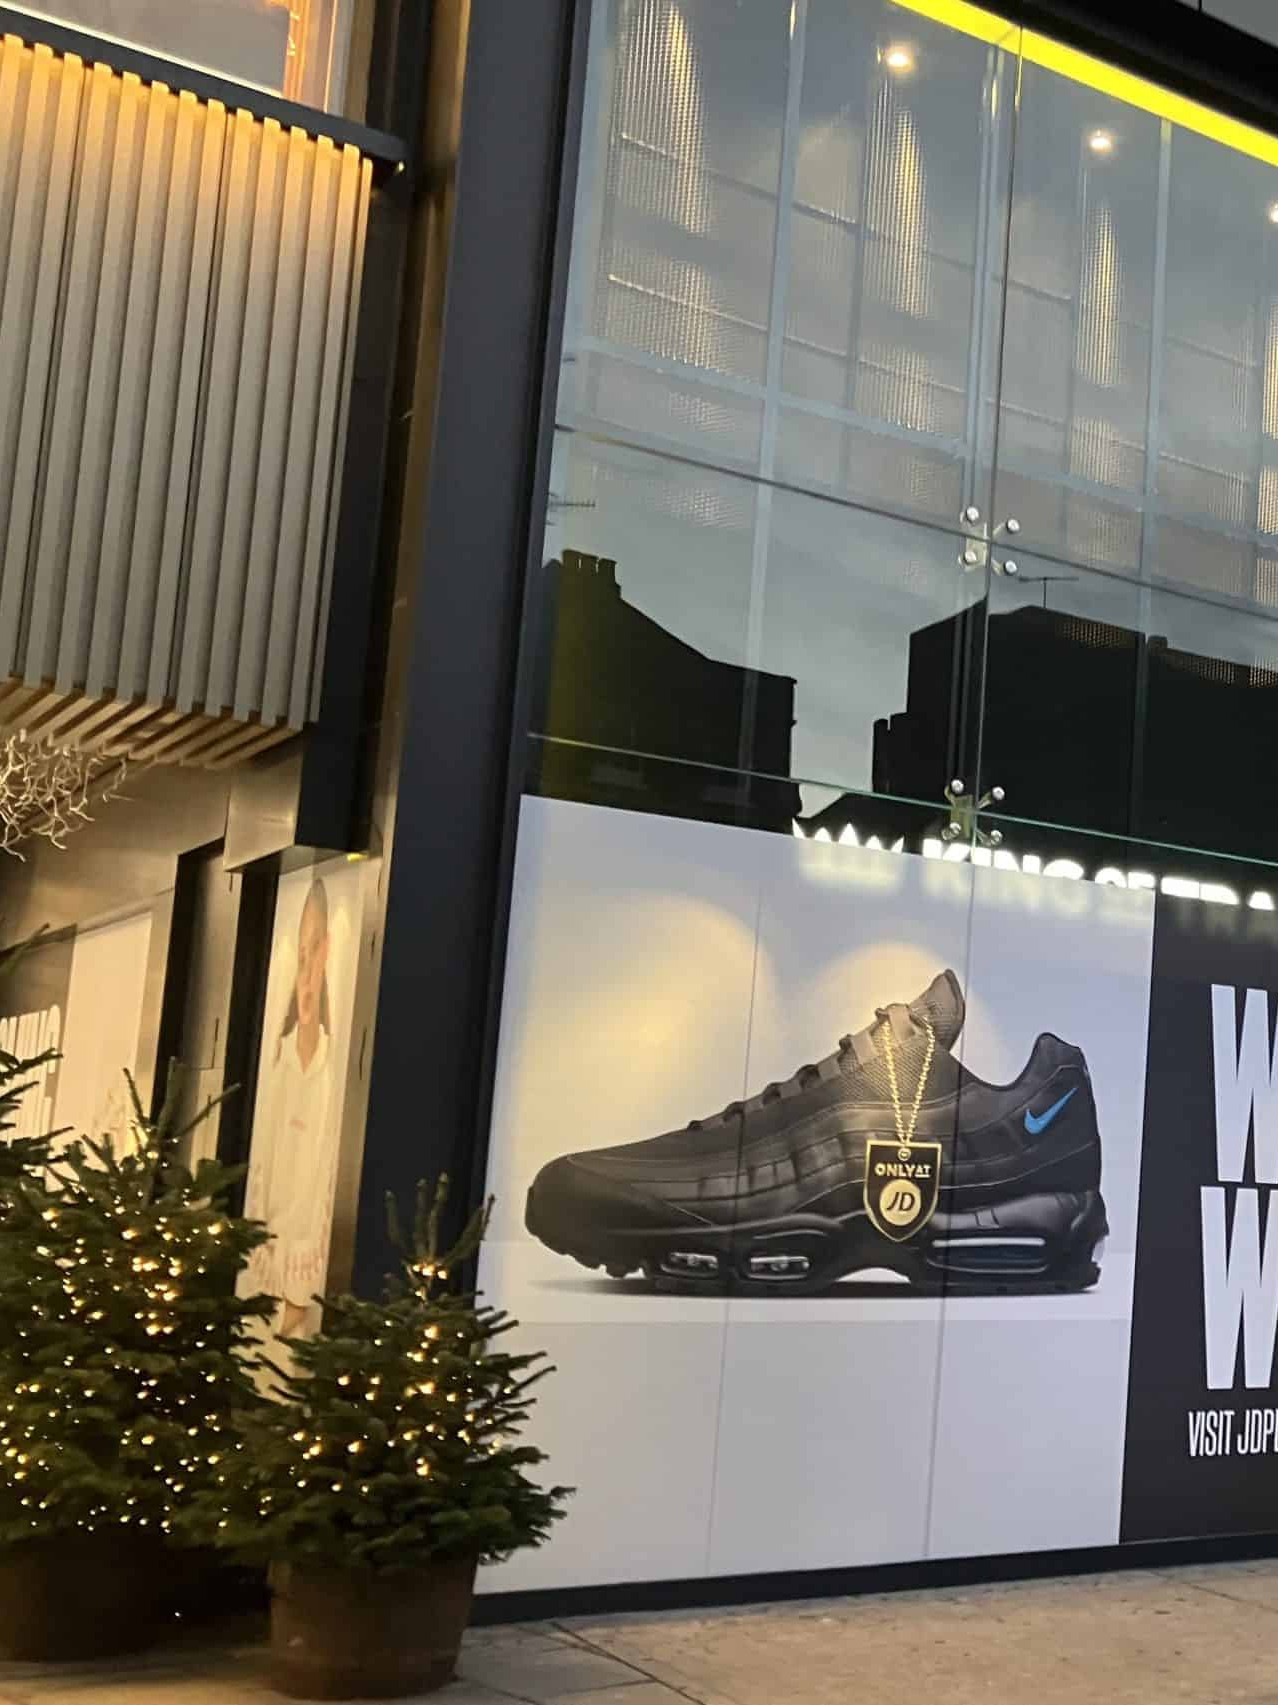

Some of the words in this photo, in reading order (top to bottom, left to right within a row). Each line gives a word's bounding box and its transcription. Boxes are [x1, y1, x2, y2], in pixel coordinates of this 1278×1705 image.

[874, 1163, 915, 1178] ONLY
[915, 1164, 932, 1178] AT
[886, 1192, 915, 1211] JD
[1188, 1410, 1235, 1457] VISIT
